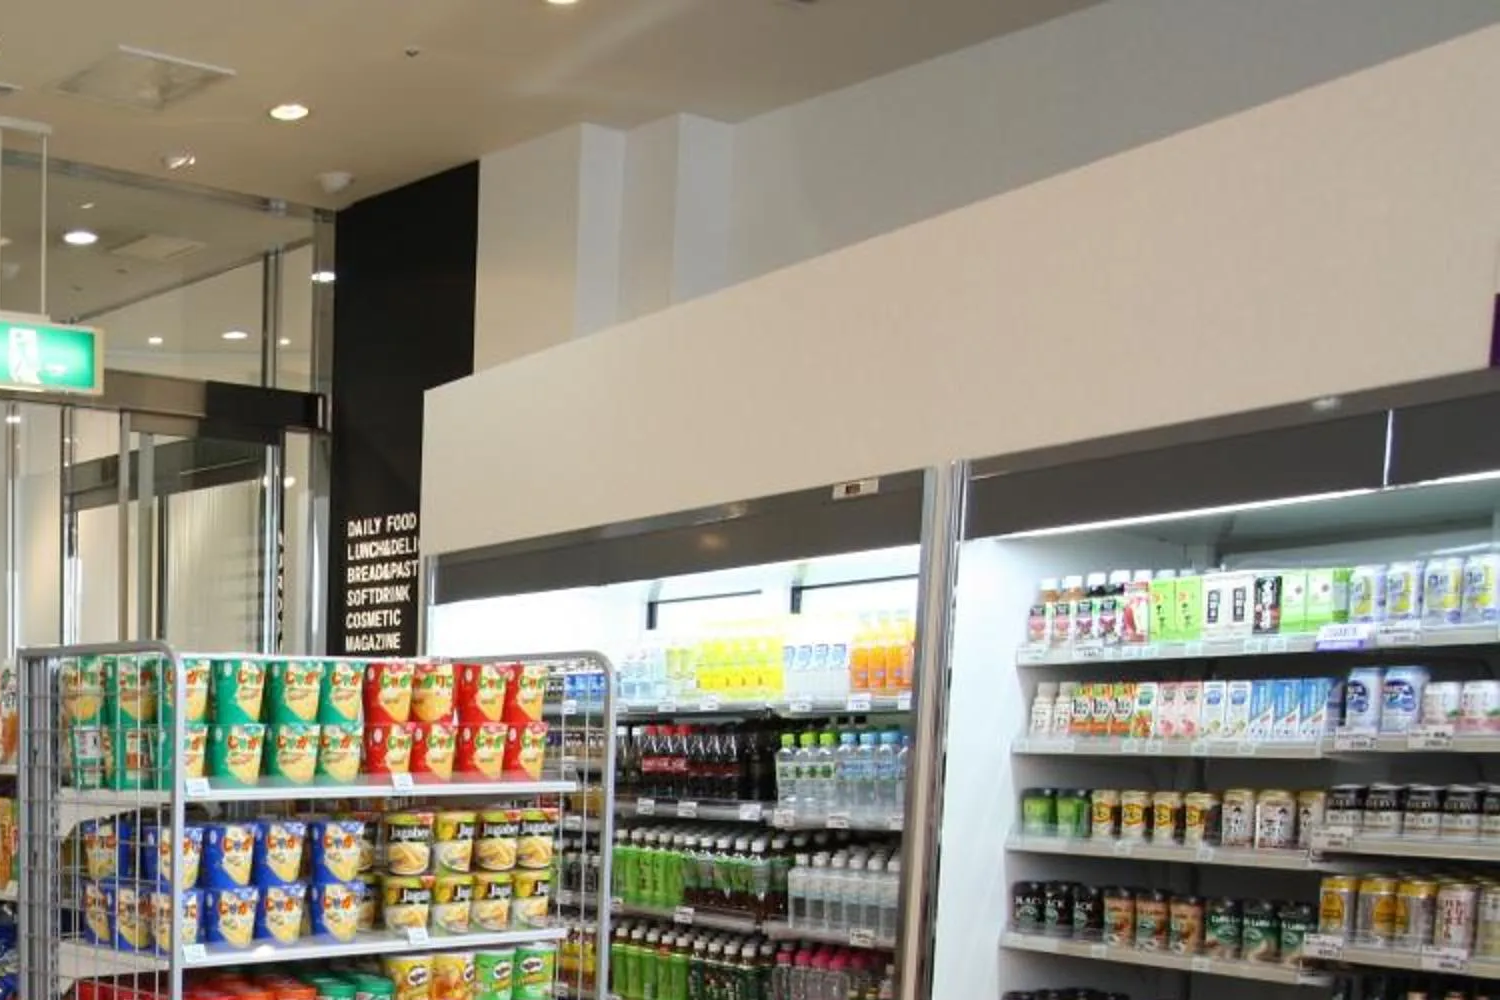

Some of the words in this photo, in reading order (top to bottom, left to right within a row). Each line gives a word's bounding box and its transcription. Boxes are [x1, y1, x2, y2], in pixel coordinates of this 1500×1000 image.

[347, 517, 382, 538] DAILY
[387, 512, 417, 532] FOOD
[347, 536, 420, 561] LUNCH&DELI
[345, 609, 401, 629] COSMETIC
[345, 632, 401, 652] MAGAZINE
